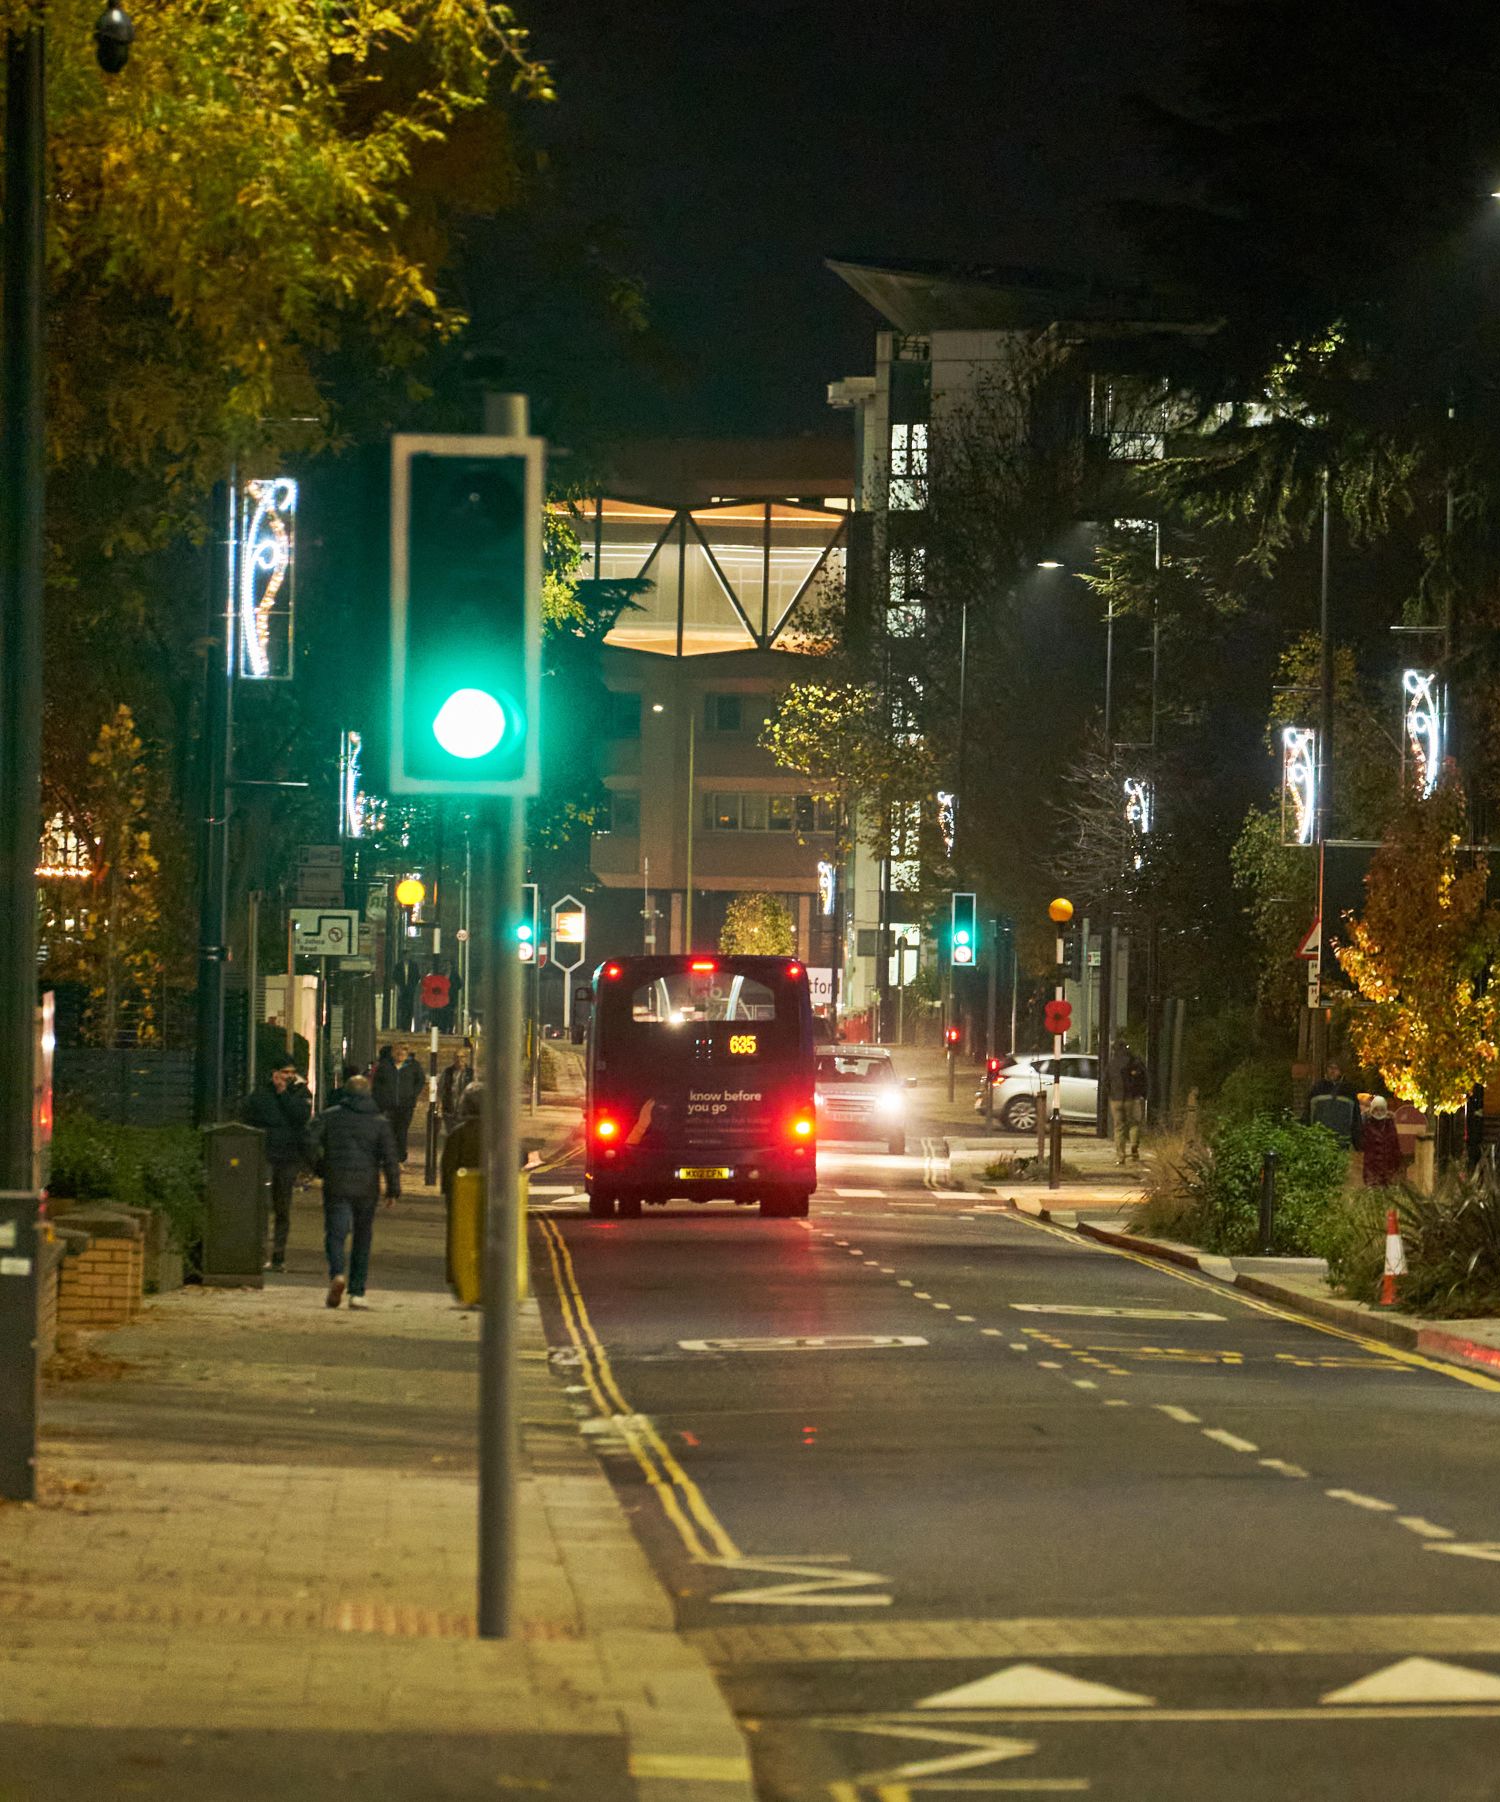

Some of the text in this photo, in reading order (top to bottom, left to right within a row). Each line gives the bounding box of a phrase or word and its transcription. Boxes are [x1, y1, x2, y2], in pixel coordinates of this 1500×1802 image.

[729, 1035, 757, 1054] 635
[689, 1089, 762, 1102] know before
[687, 1103, 728, 1115] you go
